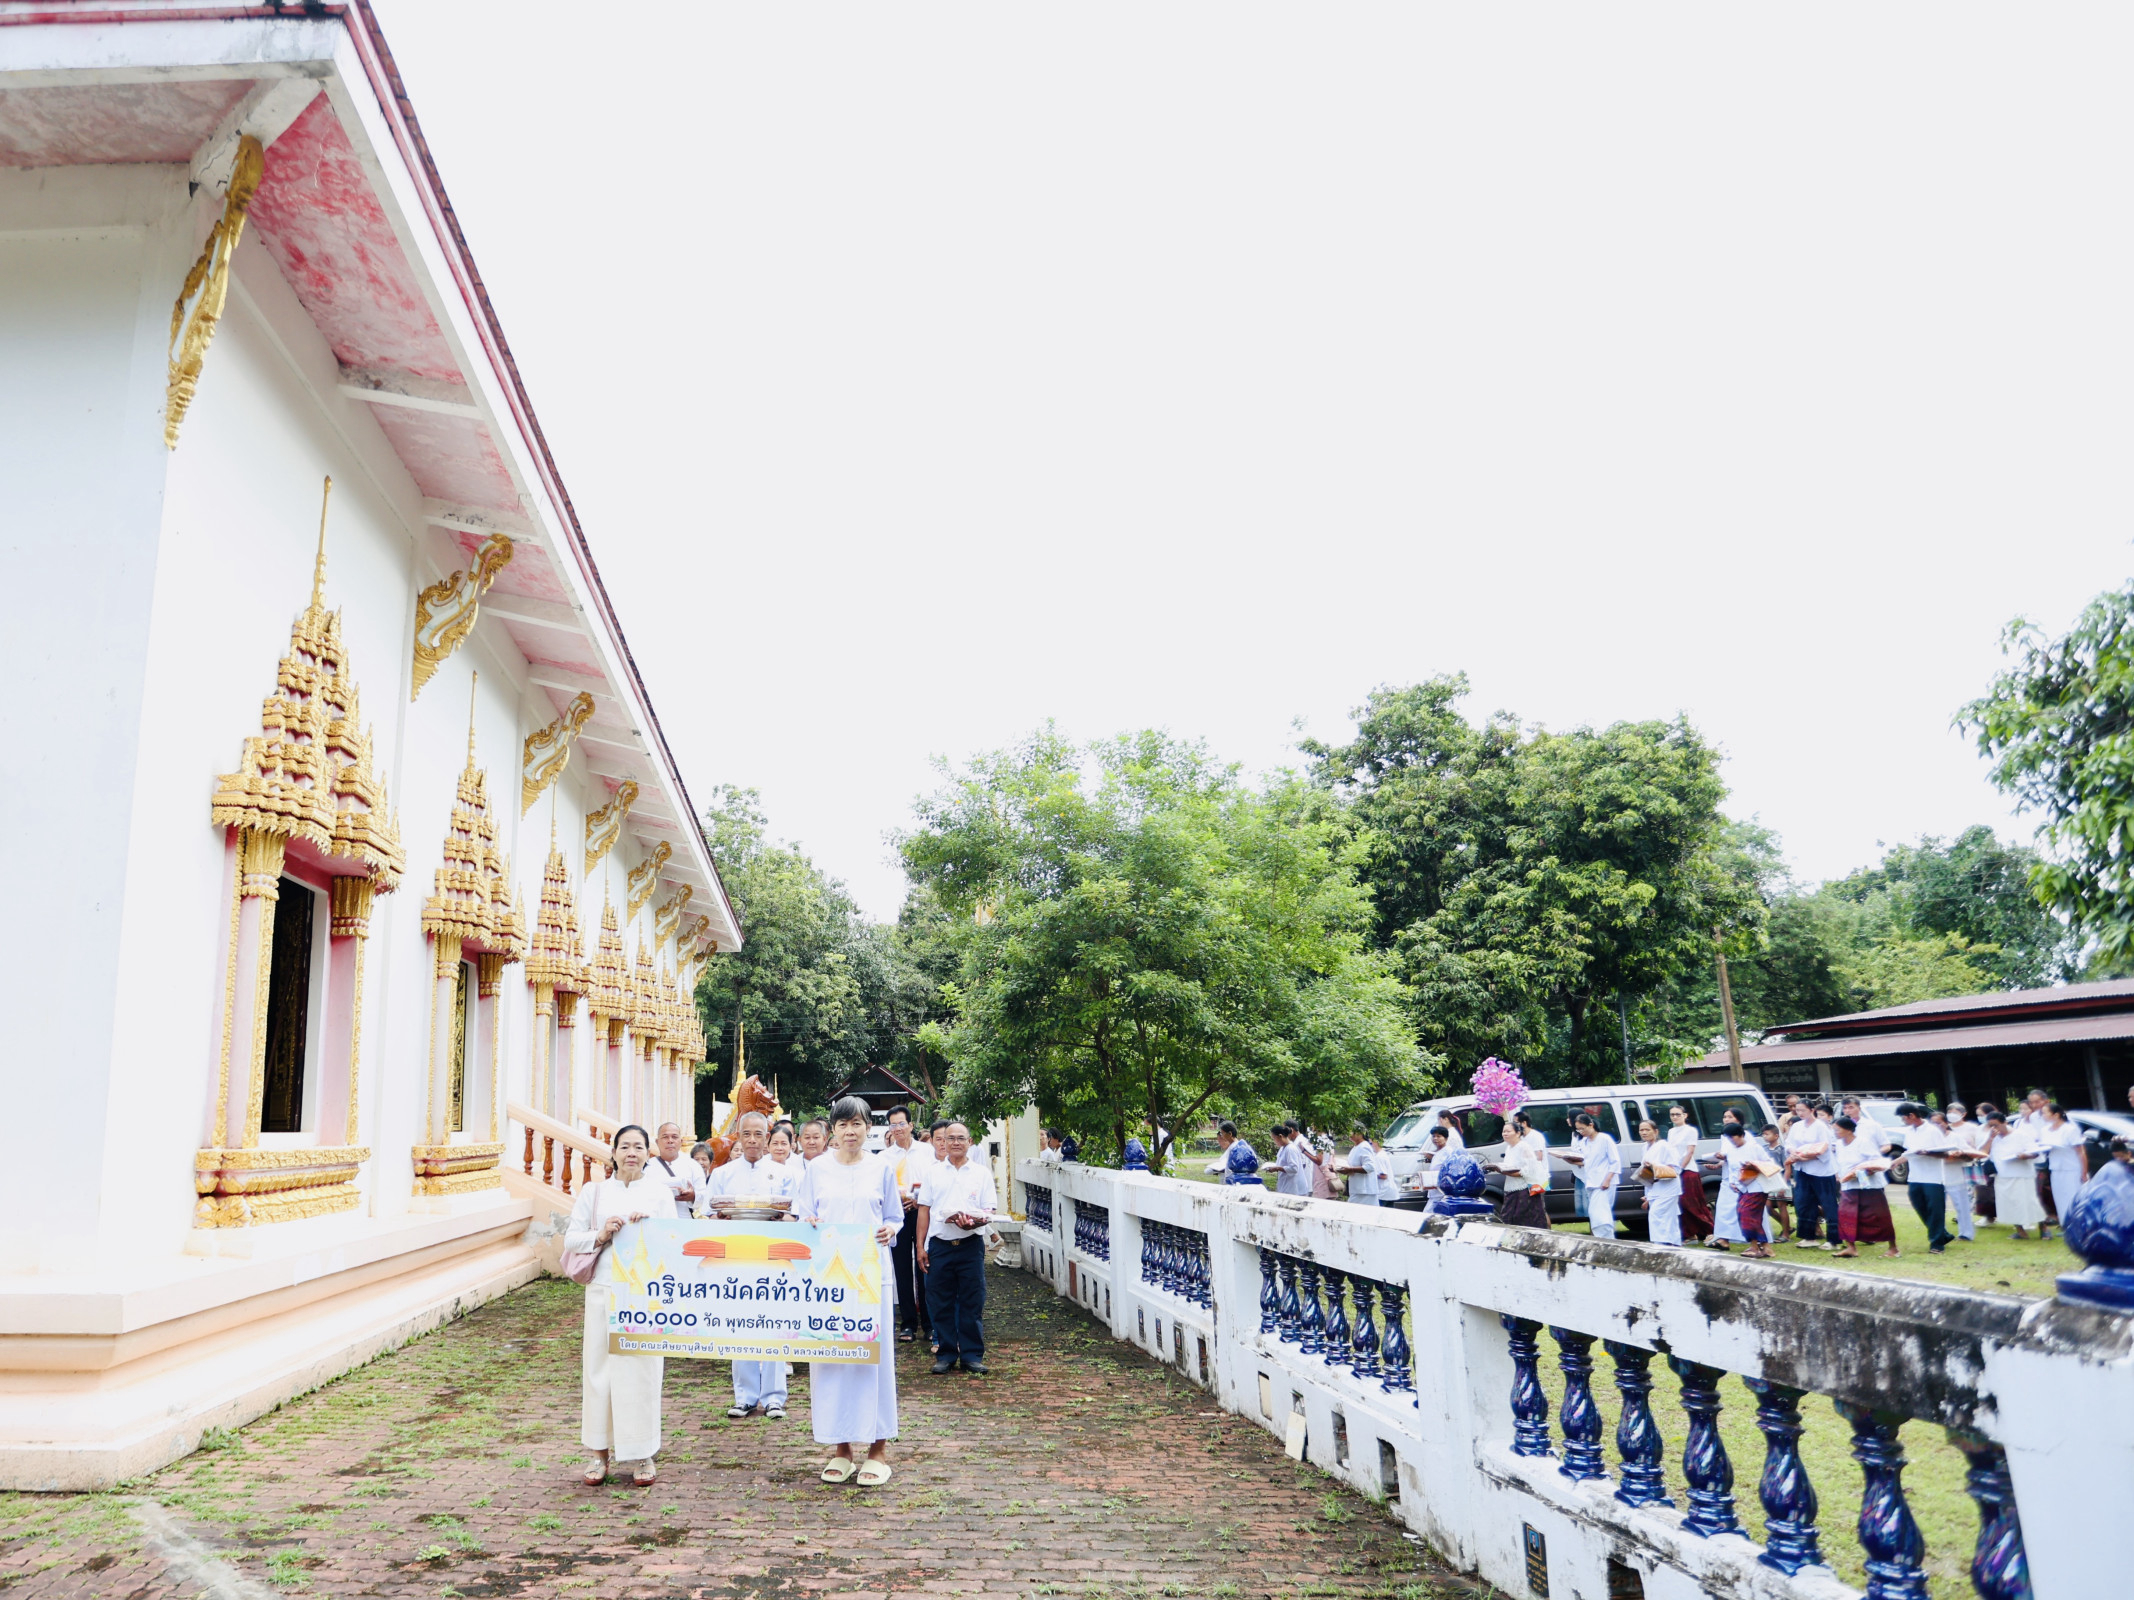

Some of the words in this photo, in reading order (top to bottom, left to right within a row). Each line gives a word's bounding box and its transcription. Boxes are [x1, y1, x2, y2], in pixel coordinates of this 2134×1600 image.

[647, 1272, 844, 1304] กฐินสามัคคีทั่วไทย
[618, 1310, 697, 1327] ๓๐,๐๐๐
[704, 1312, 721, 1327] วัด
[725, 1314, 801, 1333] พุทธศักราช
[808, 1315, 873, 1332] ๒๕๖๘
[620, 1339, 637, 1349] โดย
[641, 1341, 714, 1354] คณะศิษยานุศิษย์
[717, 1345, 761, 1356] บูชาธรรม
[782, 1345, 790, 1355] ปี
